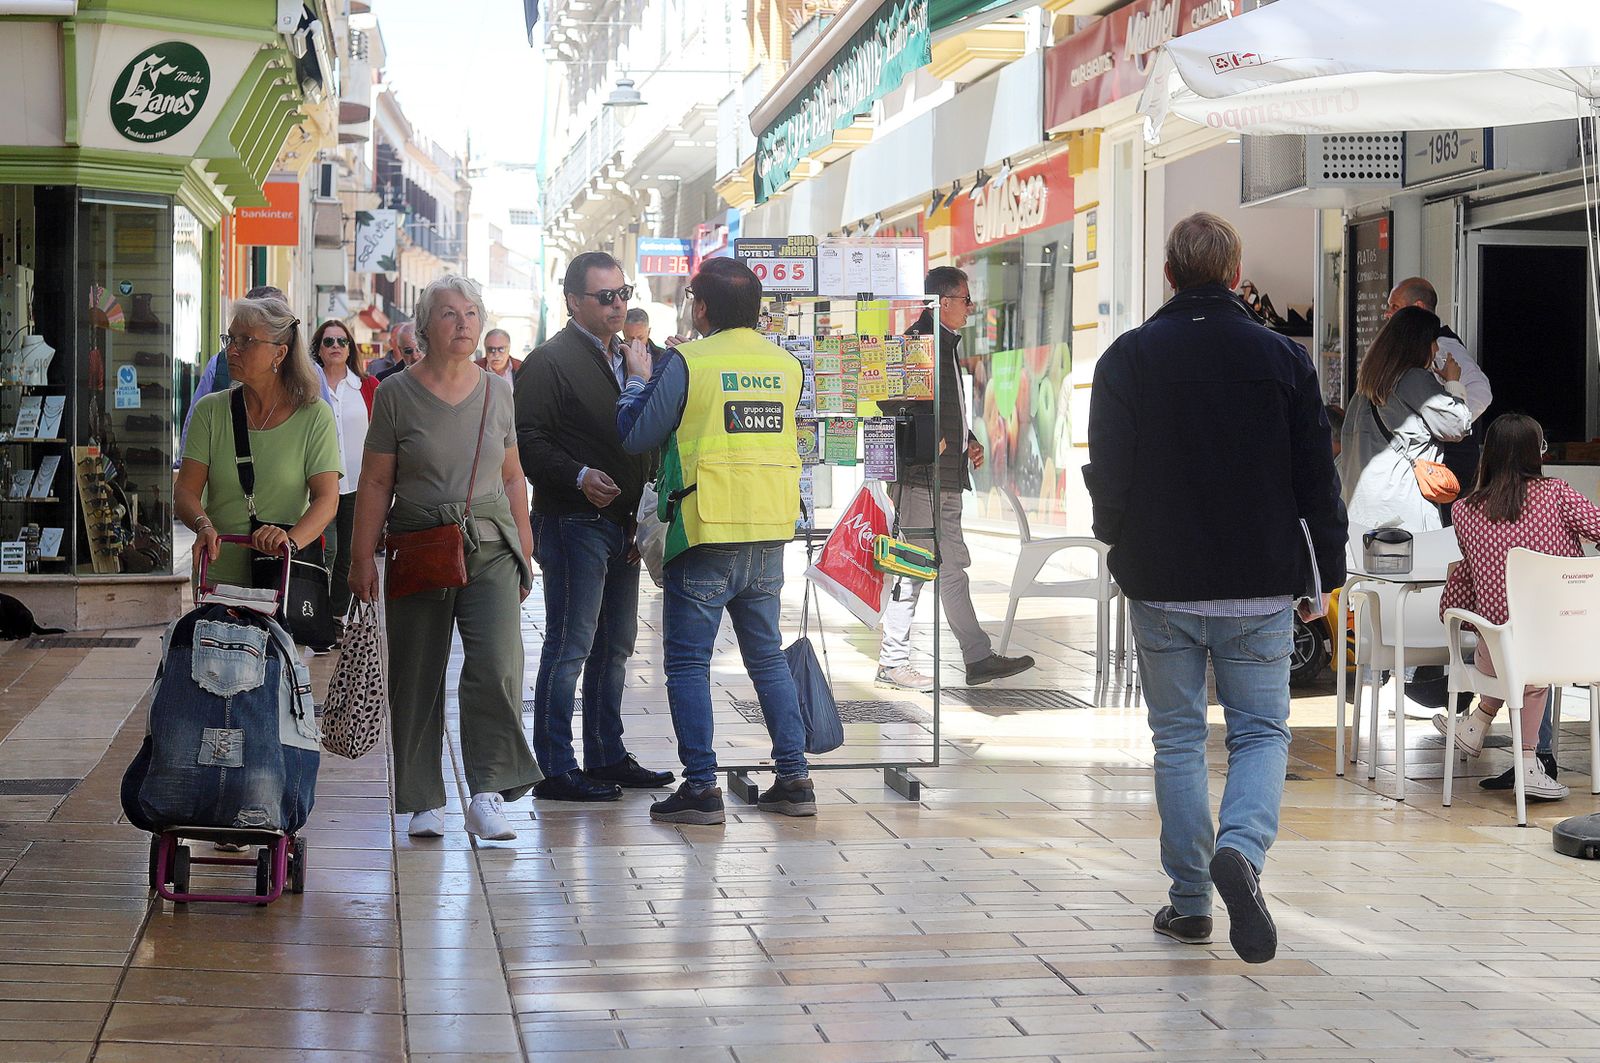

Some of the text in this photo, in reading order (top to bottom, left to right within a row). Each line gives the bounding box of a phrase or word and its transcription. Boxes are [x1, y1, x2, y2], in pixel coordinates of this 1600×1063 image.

[1429, 130, 1459, 165] 1963
[778, 246, 817, 257] JACKPO
[740, 375, 781, 389] ONCE
[743, 405, 782, 414] grupo social
[744, 415, 781, 429] ONCE
[1561, 573, 1594, 581] Cruzcampo
